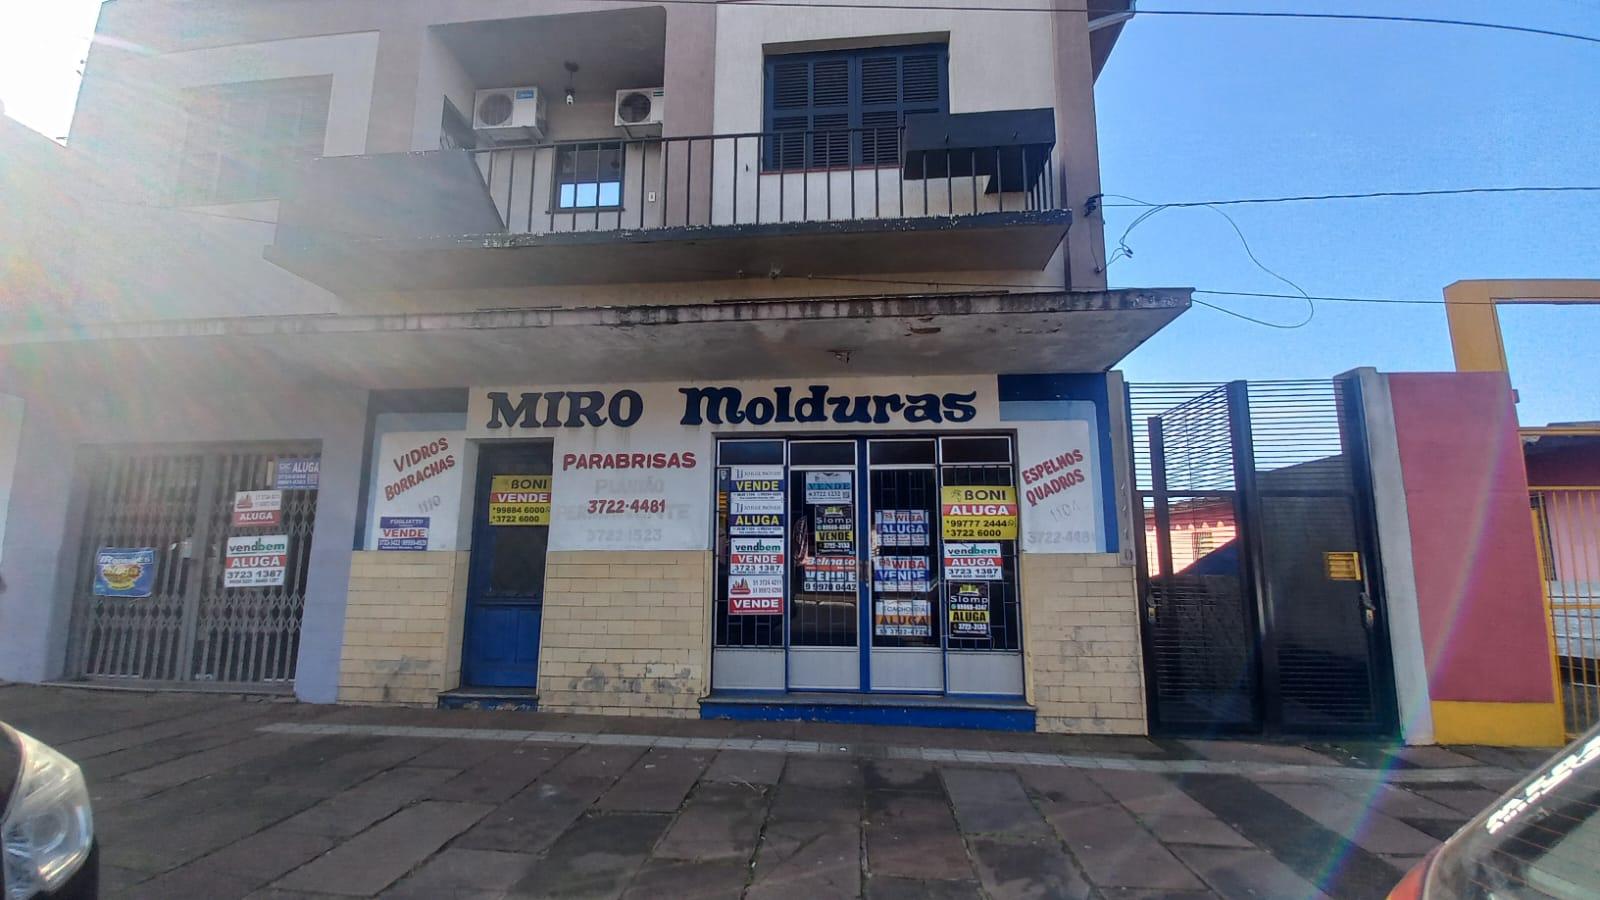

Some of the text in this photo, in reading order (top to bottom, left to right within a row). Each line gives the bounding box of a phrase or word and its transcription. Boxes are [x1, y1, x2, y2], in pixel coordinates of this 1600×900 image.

[486, 384, 977, 429] MIRO Molduras
[393, 437, 449, 473] VIDROS
[292, 461, 319, 472] ALUGA
[562, 452, 697, 471] PARABRISAS
[1021, 448, 1084, 485] ESPELHOS
[384, 454, 456, 502] BORRACHAS
[511, 479, 547, 489] BONI
[735, 481, 779, 491] VENDE
[808, 482, 850, 490] VENDE
[1025, 468, 1085, 507] QUADROS
[497, 493, 548, 502] VENDE
[964, 489, 1007, 500] BONI
[949, 504, 1009, 516] ALUGA
[240, 512, 273, 521] ALUGA
[735, 515, 780, 525] ALUGA
[383, 528, 425, 538] VENDE
[882, 524, 925, 534] ALUGA
[977, 529, 1001, 537] 6000
[818, 531, 851, 541] VENDE
[229, 538, 285, 552] vendbem
[735, 539, 781, 551] vendbem
[947, 544, 998, 554] vendbem
[231, 556, 281, 568] ALUGA
[738, 555, 778, 563] VENDE
[951, 558, 996, 566] ALUGA
[892, 560, 926, 569] WIBA
[227, 569, 282, 579] 3723 1387
[879, 570, 926, 580] VENDE
[733, 599, 780, 609] VENDE
[950, 595, 988, 604] Slomp
[880, 615, 928, 625] ALUGA
[953, 611, 986, 621] ALUGA
